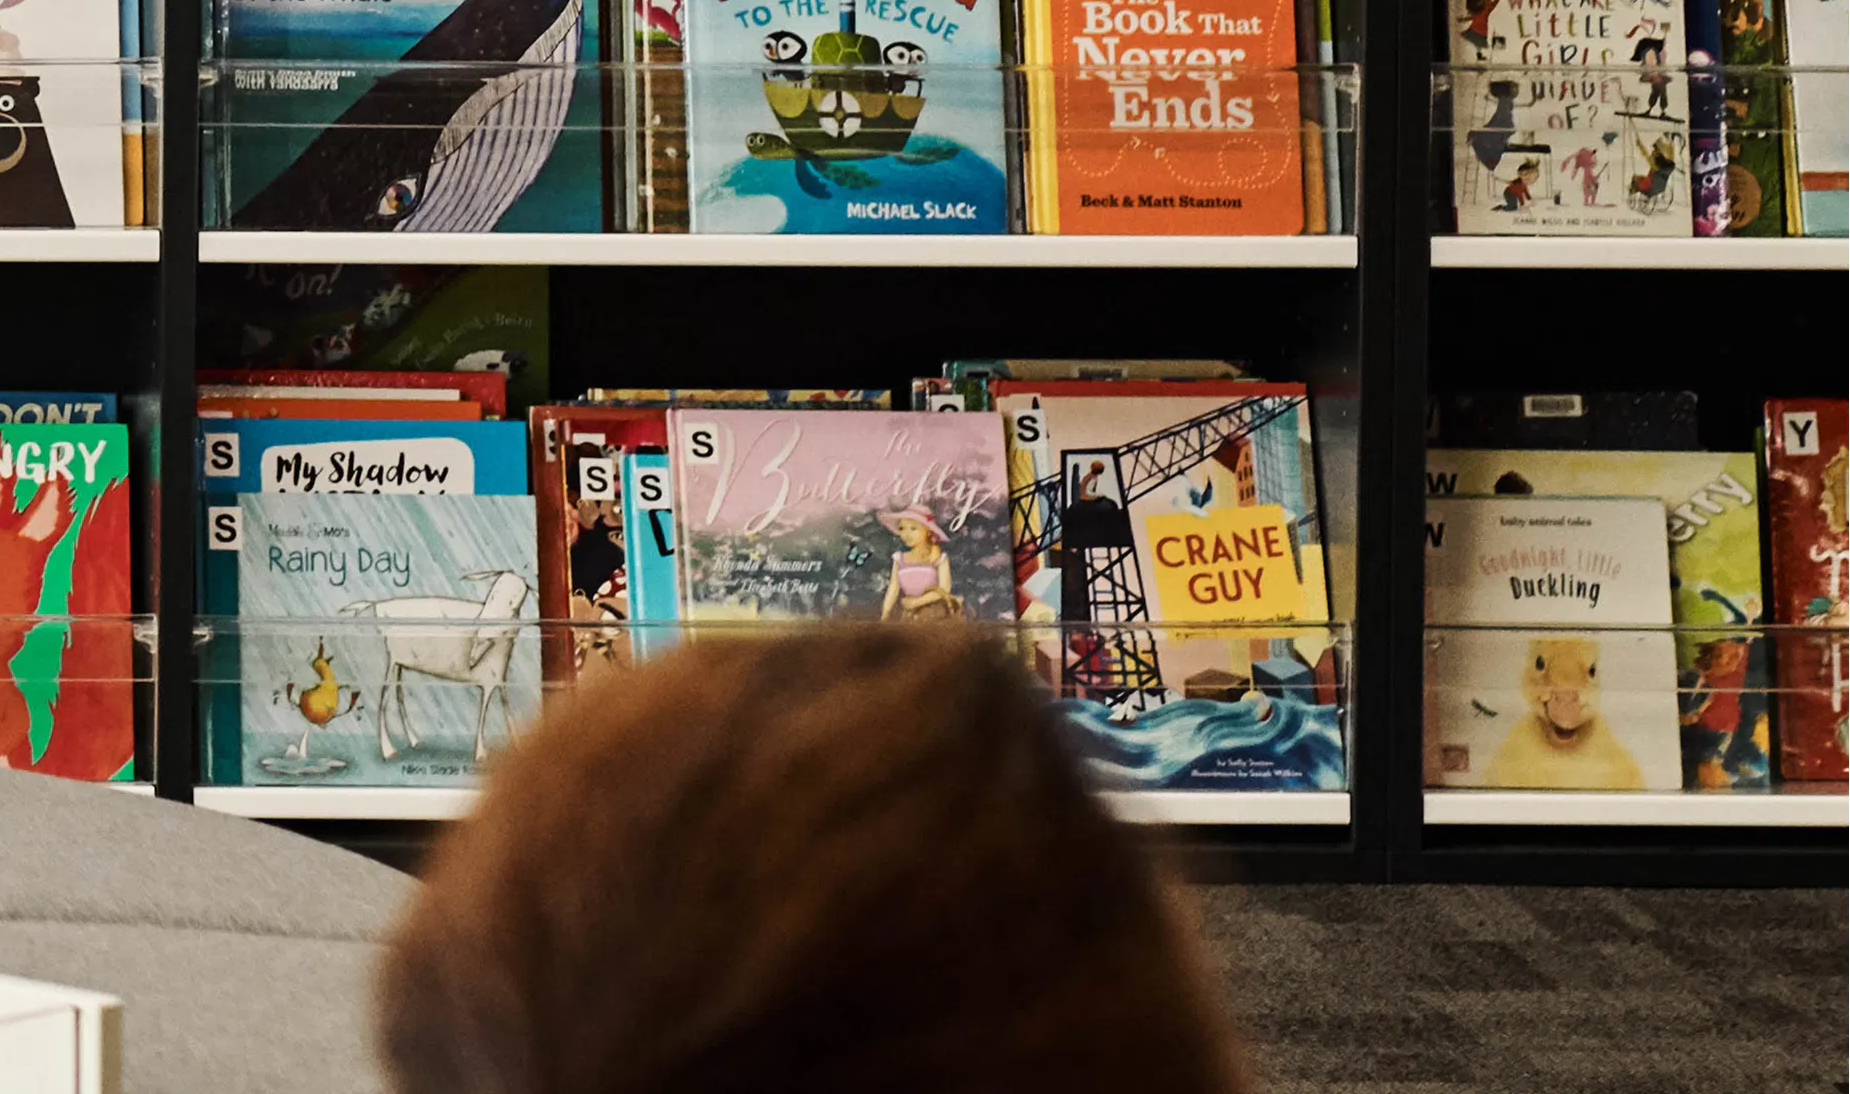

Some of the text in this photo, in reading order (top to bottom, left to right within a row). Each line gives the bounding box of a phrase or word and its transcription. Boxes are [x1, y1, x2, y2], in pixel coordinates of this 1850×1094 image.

[735, 6, 772, 29] TO
[1081, 2, 1263, 35] Book That
[1110, 83, 1254, 131] Ends
[847, 201, 977, 221] MICHAEL SLACK
[1081, 194, 1242, 209] Beck & Matt Stanton
[692, 431, 714, 458] S
[1789, 420, 1813, 448] Y
[275, 449, 450, 491] My Shadow
[214, 513, 237, 543] S
[1155, 526, 1285, 569] CRANE
[268, 546, 411, 587] Rainy Day
[1187, 567, 1265, 605] GUY
[1509, 574, 1602, 608] Duckling
